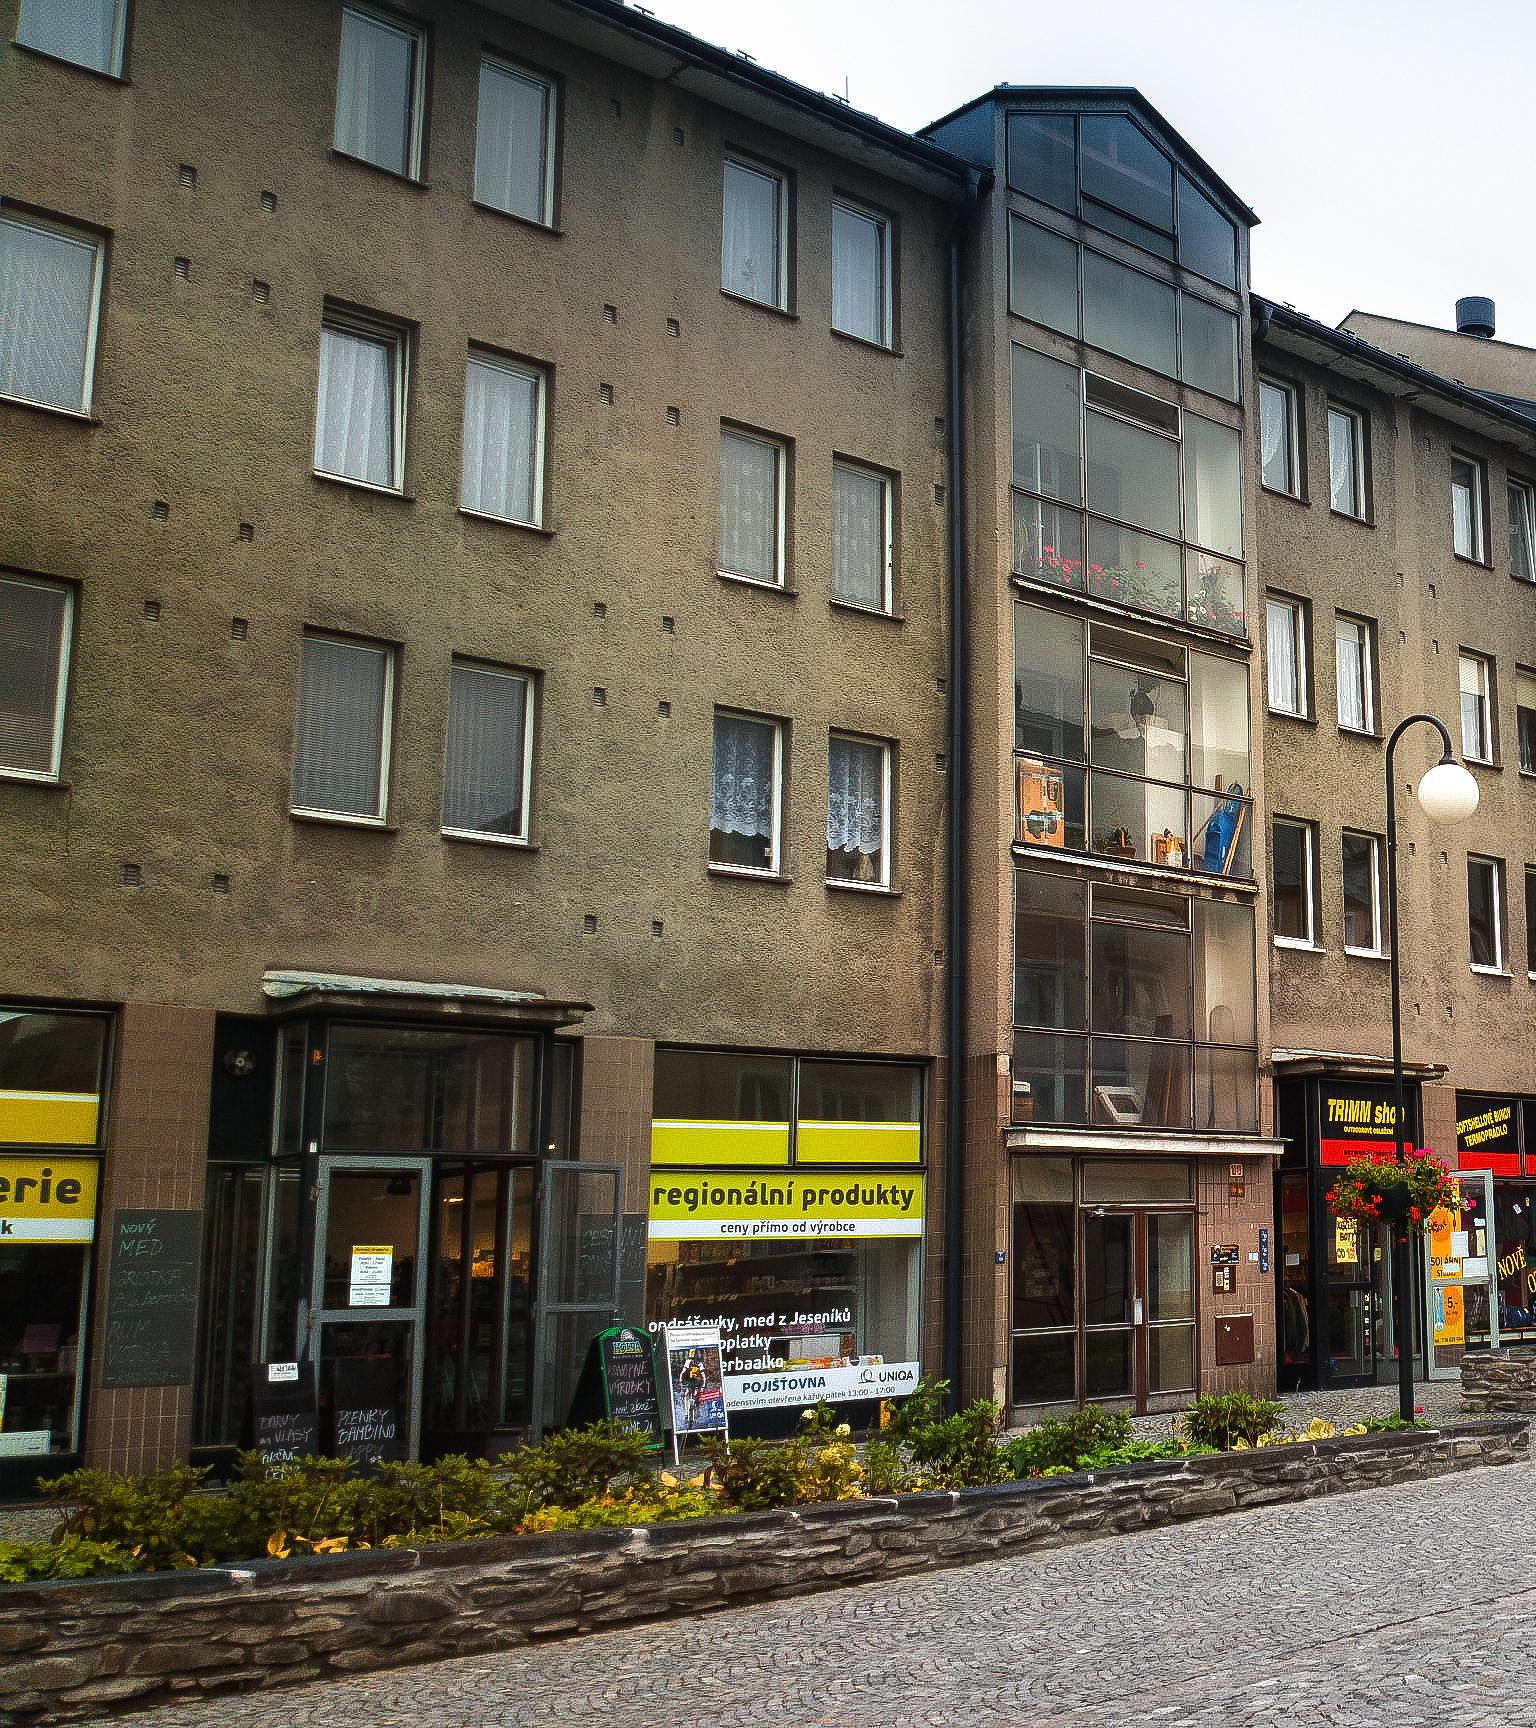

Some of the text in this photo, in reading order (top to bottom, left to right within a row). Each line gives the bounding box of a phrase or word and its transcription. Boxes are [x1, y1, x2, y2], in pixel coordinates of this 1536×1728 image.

[1327, 1098, 1405, 1124] TRIMM sho
[652, 1180, 915, 1212] regionální produkty
[720, 1219, 856, 1236] ceny přímo od výrobce
[1497, 1243, 1527, 1281] NOVĚ
[743, 1312, 775, 1328] med
[778, 1314, 787, 1325] z
[789, 1307, 851, 1326] Jeseníků
[742, 1375, 827, 1394] POJIŠŤOVNA
[878, 1369, 914, 1383] UNIQA
